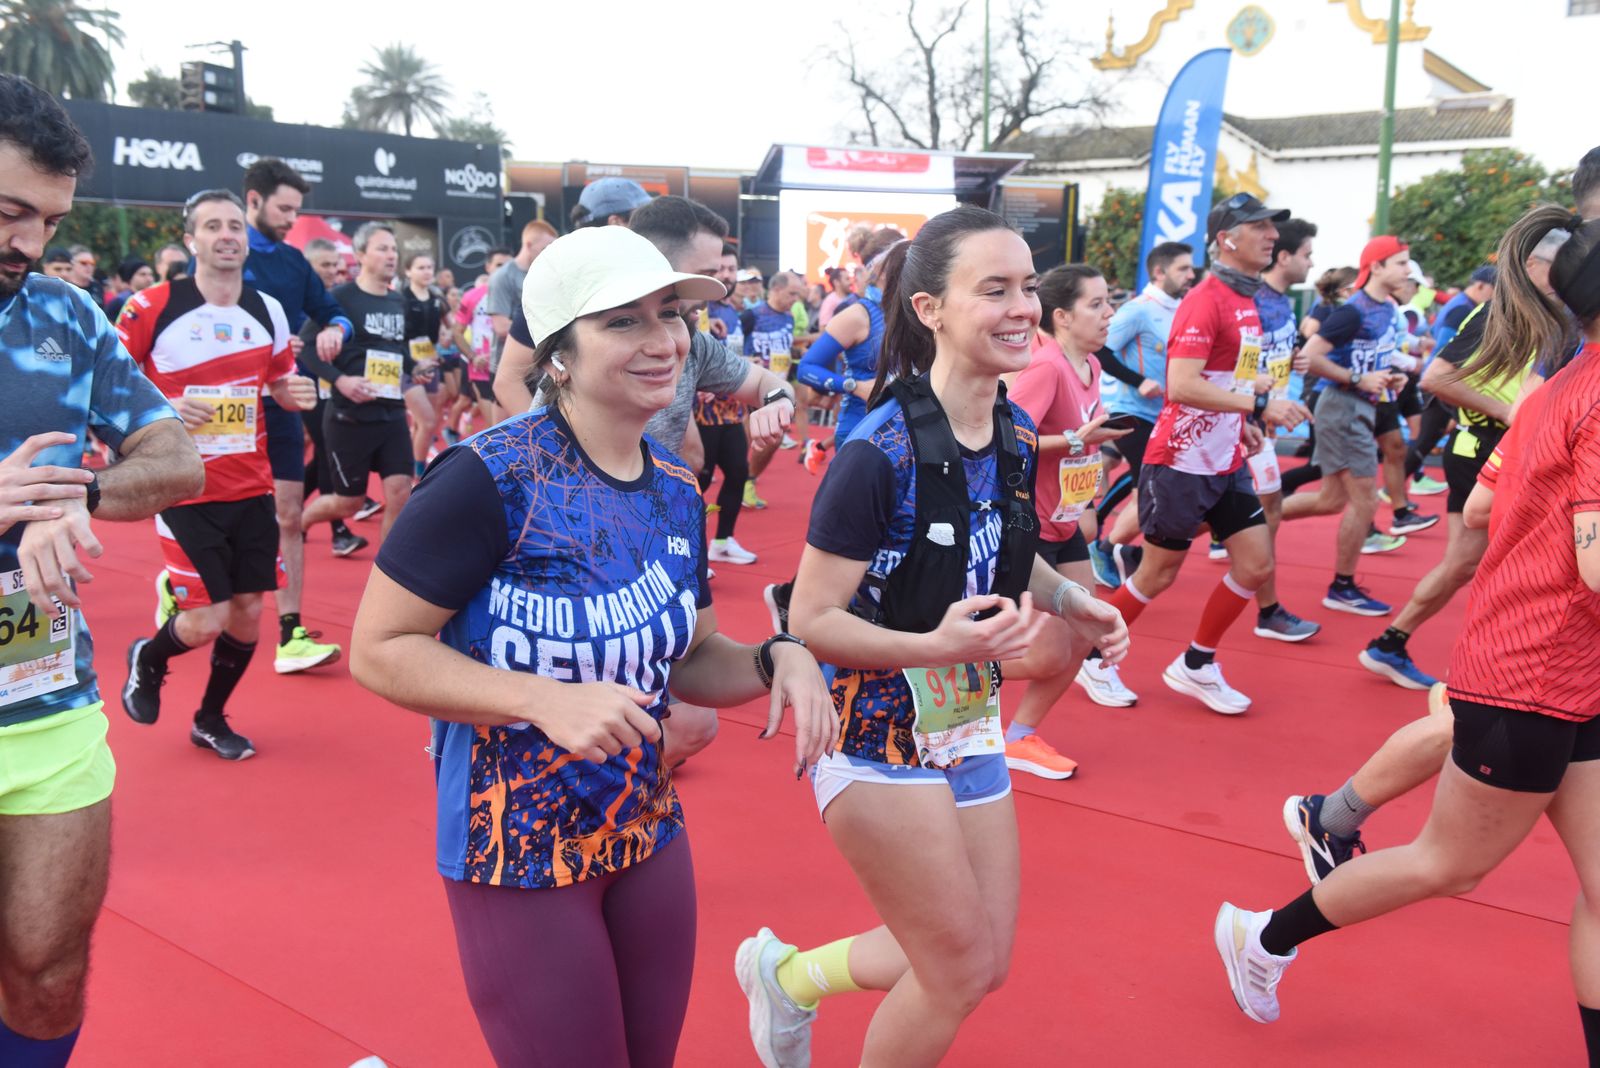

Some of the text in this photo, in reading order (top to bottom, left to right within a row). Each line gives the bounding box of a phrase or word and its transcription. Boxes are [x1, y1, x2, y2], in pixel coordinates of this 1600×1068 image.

[113, 136, 204, 172] HOKA
[1177, 100, 1200, 176] HUMAN
[1164, 141, 1181, 175] FLY
[1189, 144, 1206, 178] FLY
[208, 403, 247, 423] 120
[667, 535, 691, 558] HOKA
[488, 559, 677, 639] MEDIO MARATÓN
